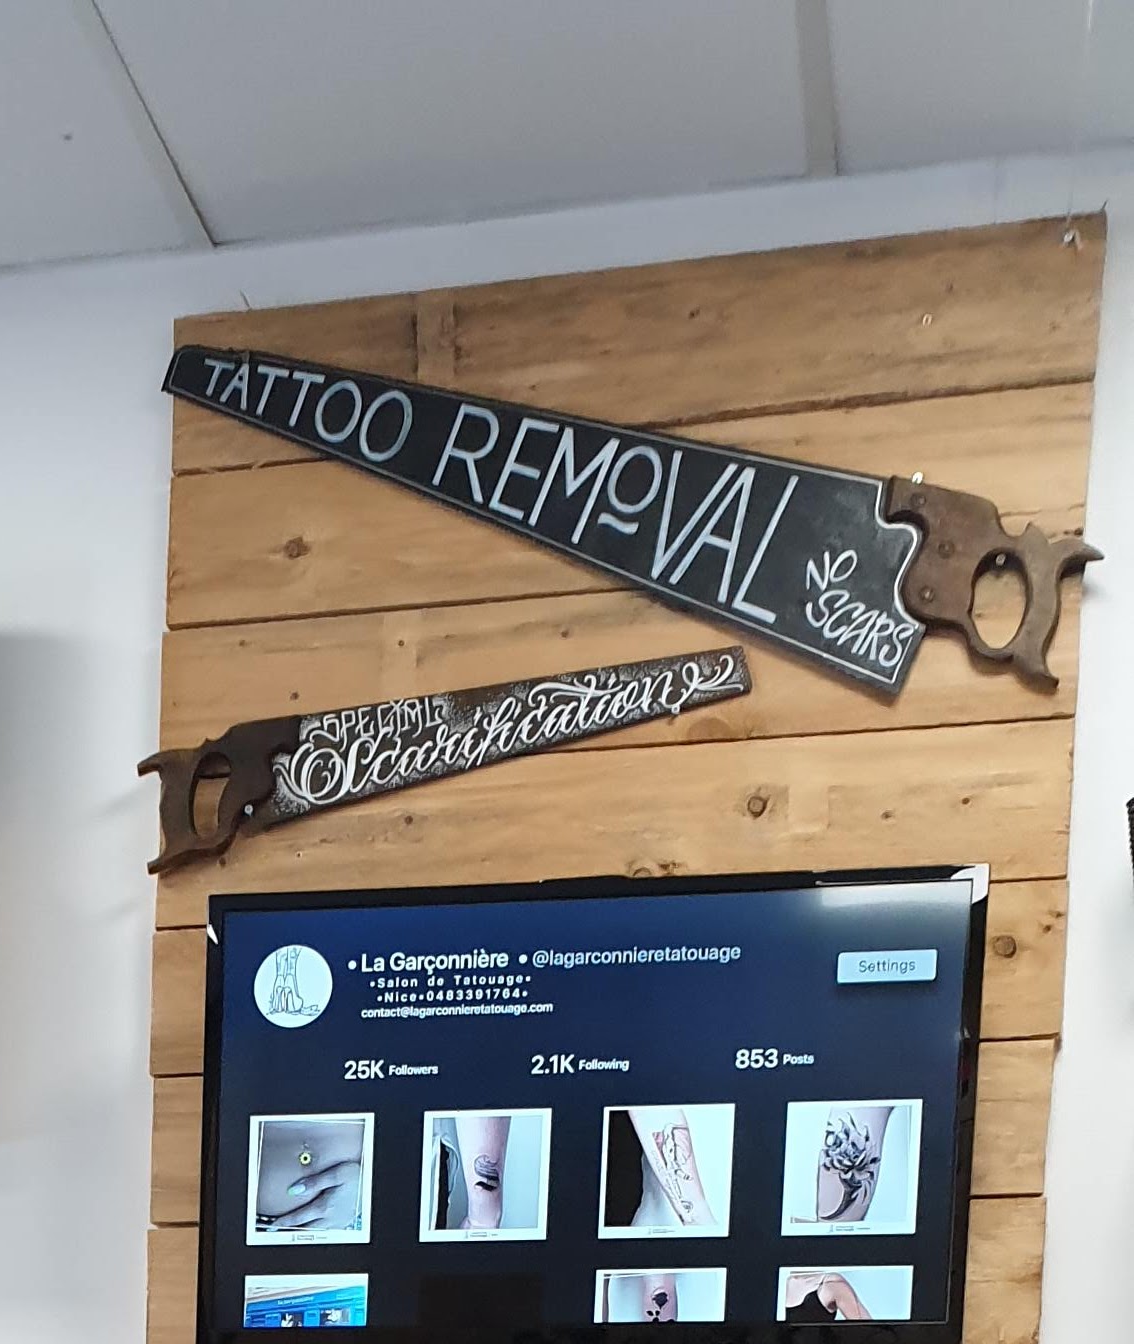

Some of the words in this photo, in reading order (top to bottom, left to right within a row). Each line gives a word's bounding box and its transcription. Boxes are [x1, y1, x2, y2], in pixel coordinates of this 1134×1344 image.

[203, 357, 415, 462] TATTOO
[433, 402, 799, 623] REMOVAL
[806, 550, 858, 591] NO
[806, 587, 914, 667] SCARS
[361, 953, 385, 973] La
[390, 949, 509, 974] Garçonnière
[532, 944, 742, 968] @lagarconnieretatouage
[857, 956, 918, 978] Settings
[428, 975, 445, 988] de
[361, 1001, 554, 1019] contact@lagarconnieretatouage.com
[530, 1054, 575, 1075] 2.1K
[578, 1056, 630, 1073] Following
[735, 1048, 778, 1069] 853
[783, 1052, 815, 1066] Posts
[343, 1060, 385, 1081] 25K
[388, 1062, 439, 1077] Followers
